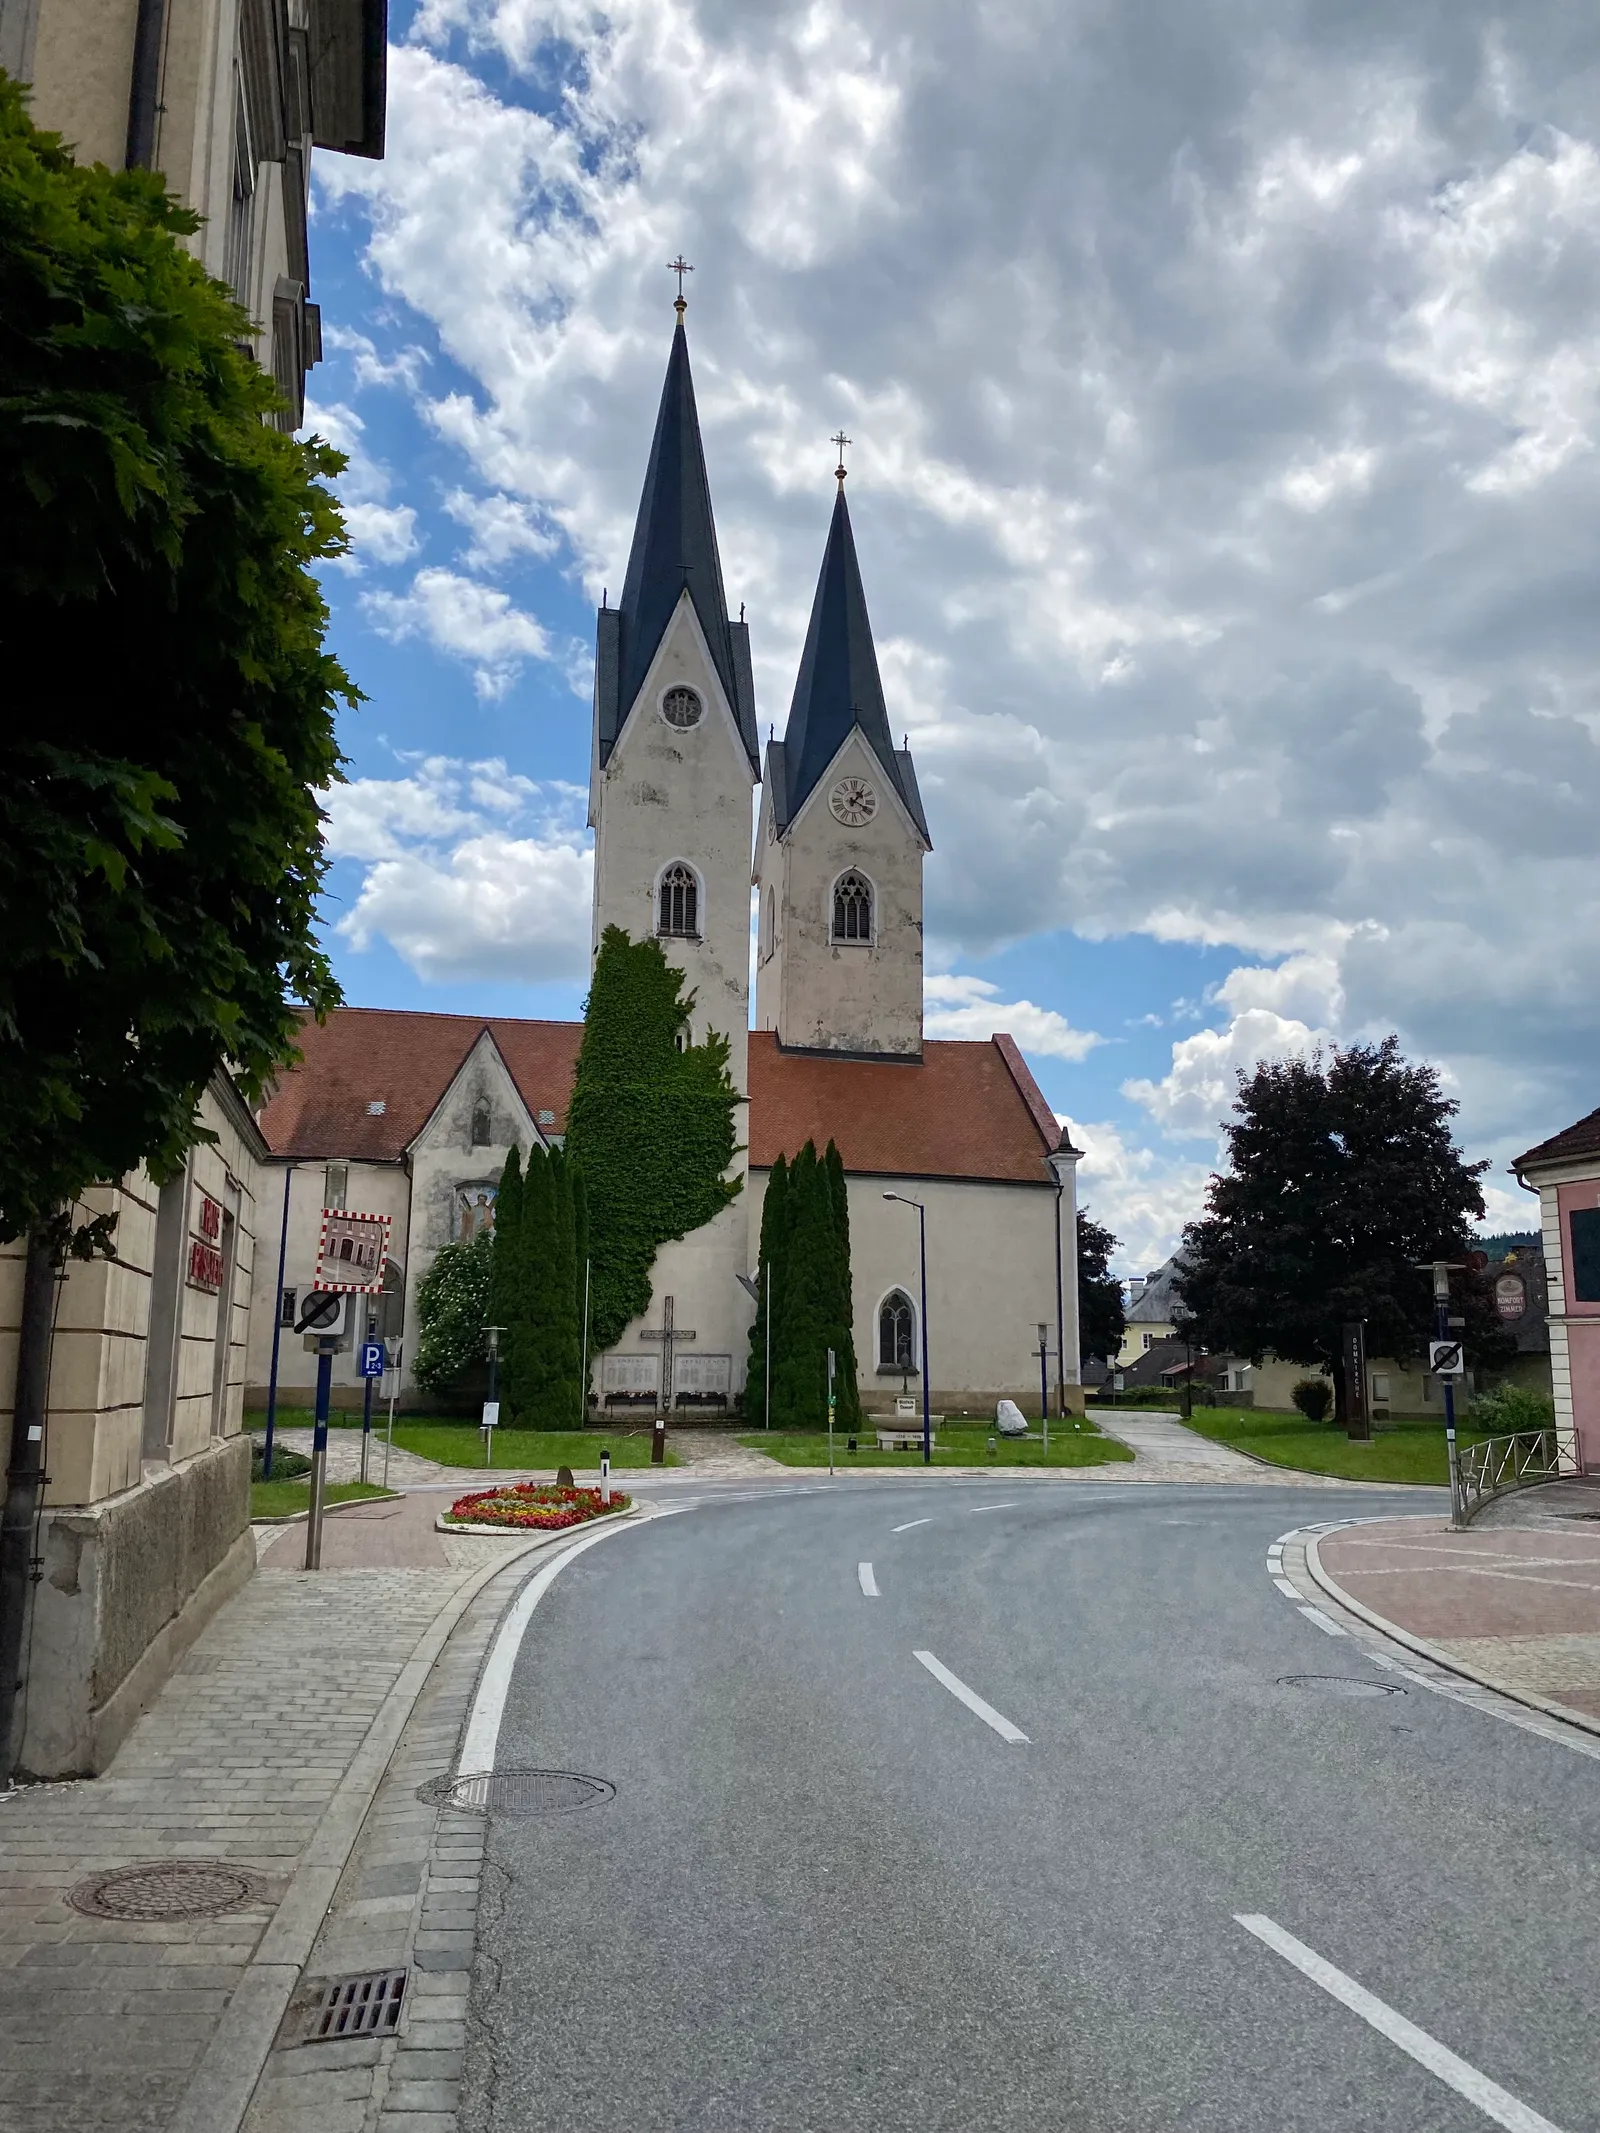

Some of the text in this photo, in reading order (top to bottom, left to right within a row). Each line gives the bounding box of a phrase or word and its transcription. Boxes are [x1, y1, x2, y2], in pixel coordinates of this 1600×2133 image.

[1497, 1297, 1524, 1305] KOMFORT
[1500, 1305, 1523, 1313] ZIMMER
[366, 1346, 380, 1369] P
[1352, 1337, 1360, 1398] DOMKIRCHE
